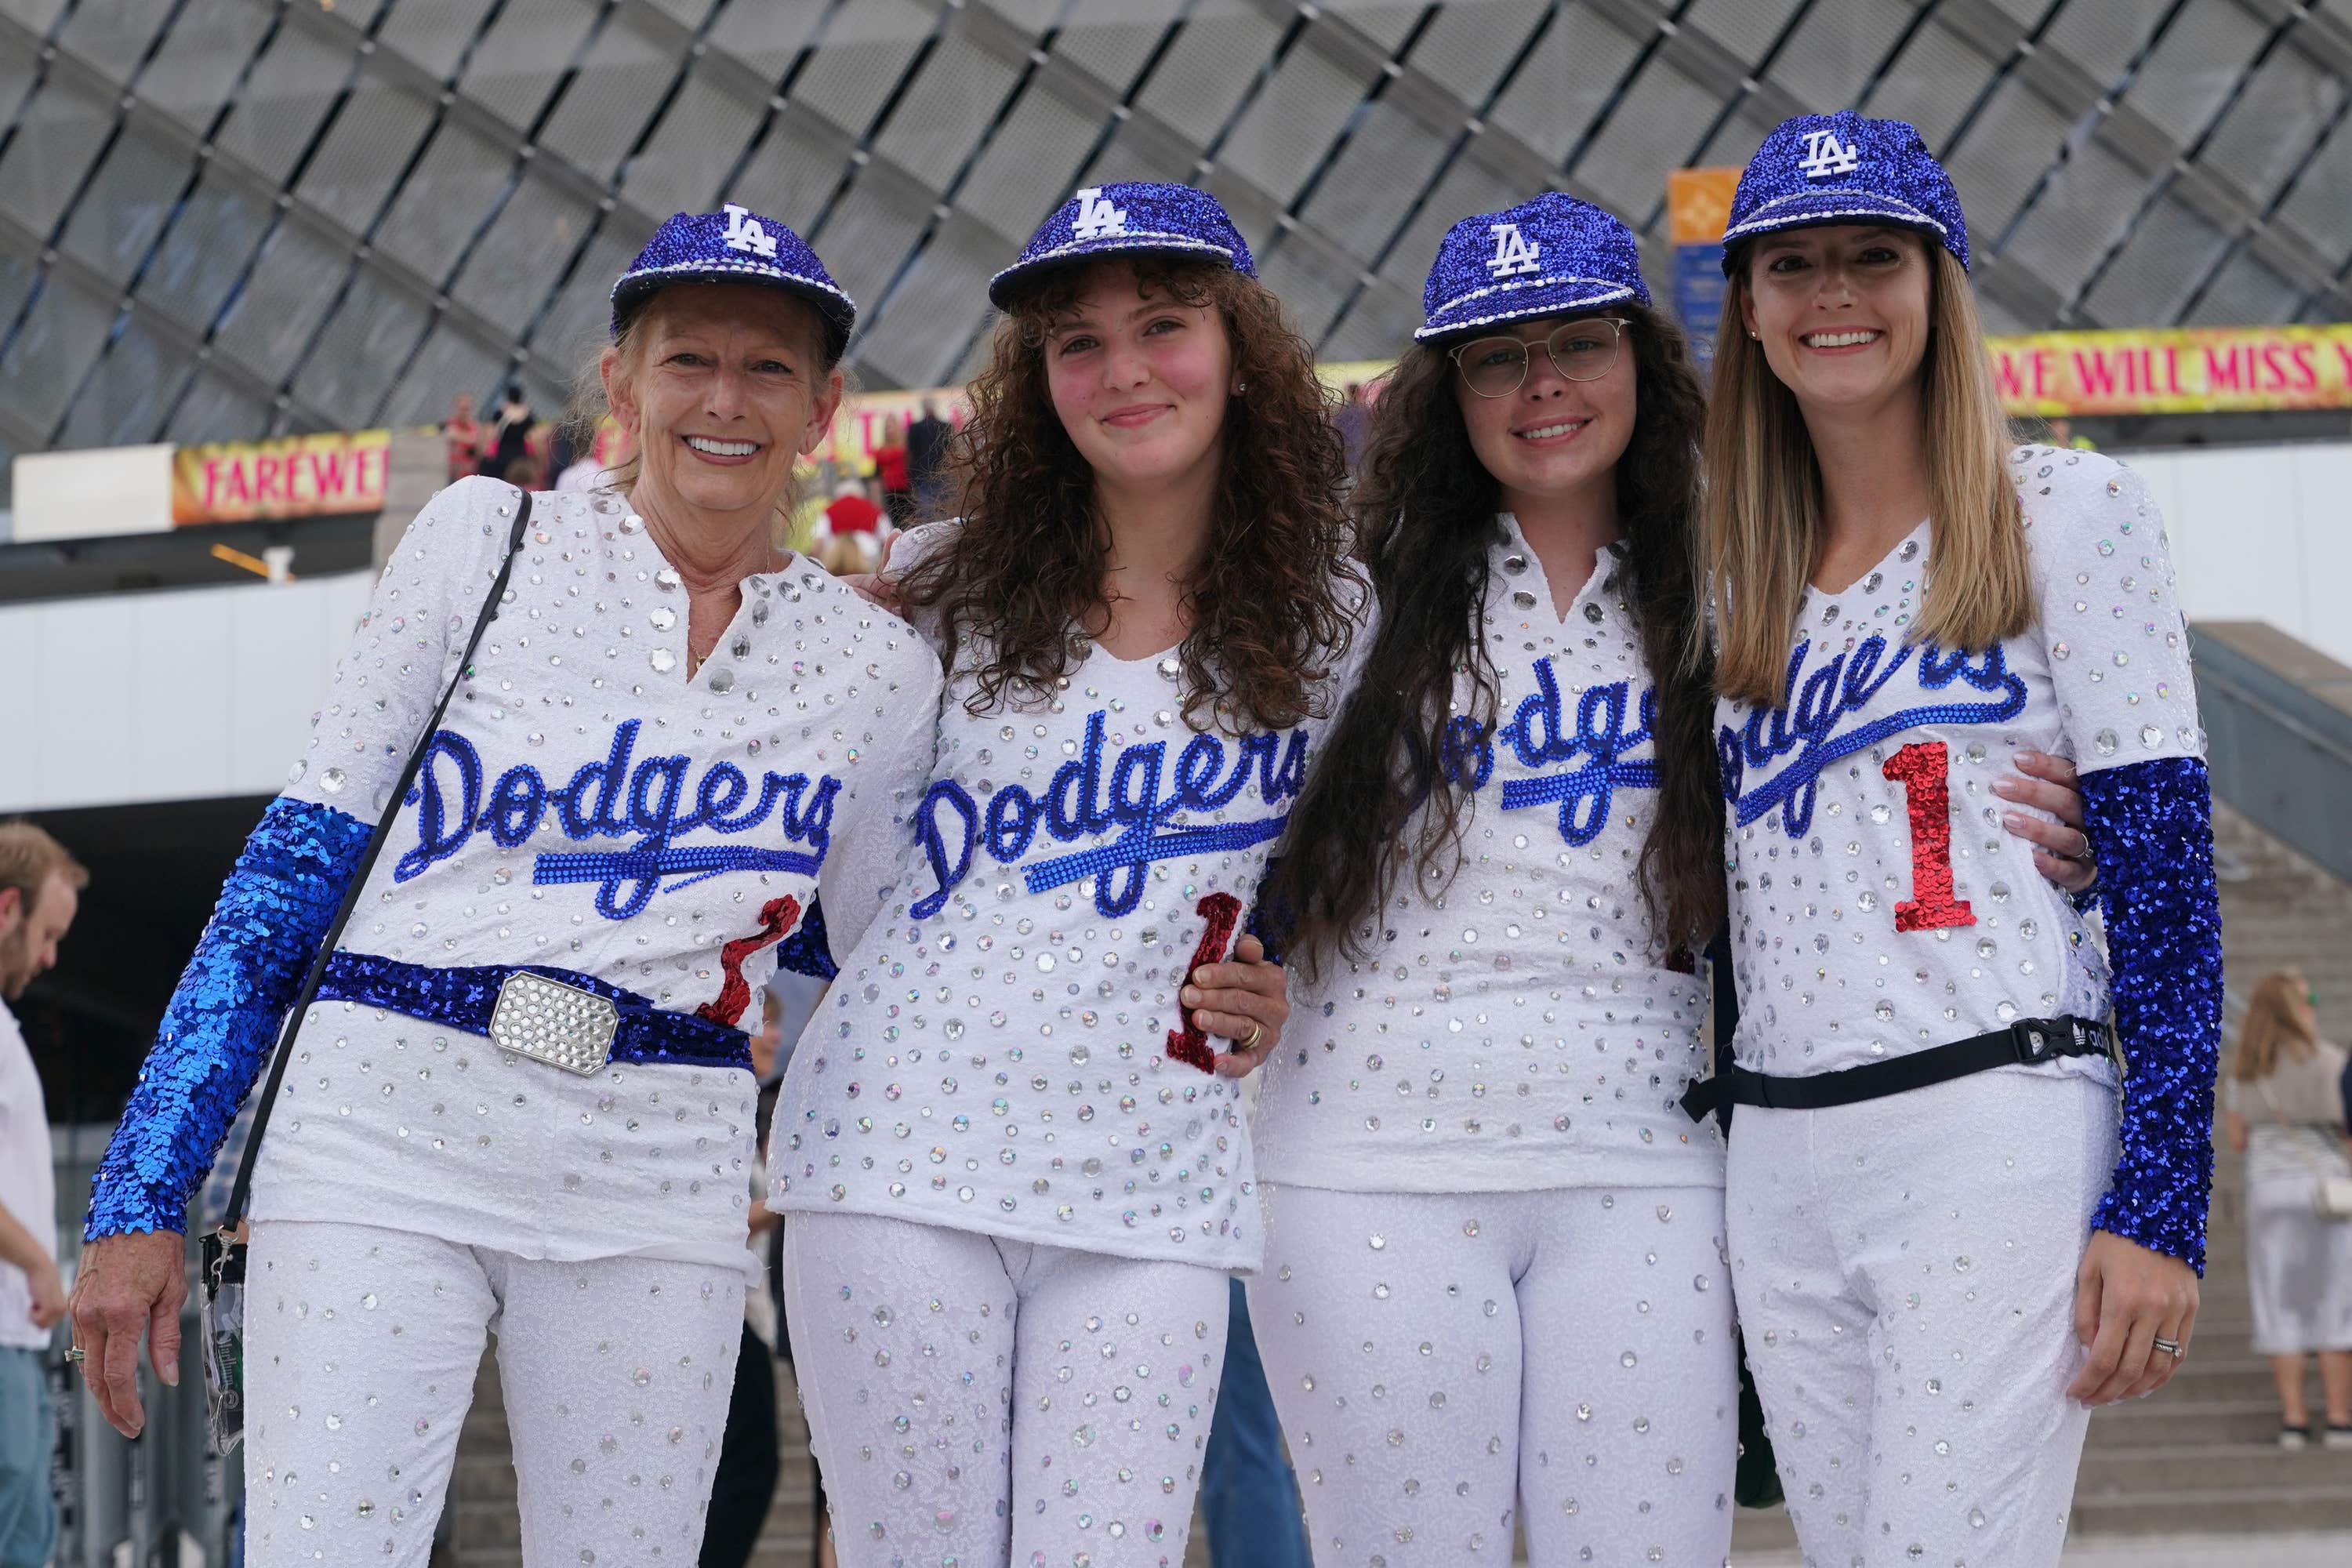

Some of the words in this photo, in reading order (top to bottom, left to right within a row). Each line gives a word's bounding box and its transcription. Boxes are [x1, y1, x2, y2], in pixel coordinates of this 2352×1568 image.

[1798, 129, 1857, 178] LA
[722, 203, 778, 258] LA
[1071, 187, 1127, 240] LA
[1486, 223, 1541, 278] LA
[2071, 348, 2180, 394] WILL
[2205, 343, 2316, 390] MISS
[393, 717, 843, 920] Dodgers
[909, 709, 1310, 919] Dodgers
[1882, 740, 1977, 932] 1
[1166, 891, 1243, 1075] 1
